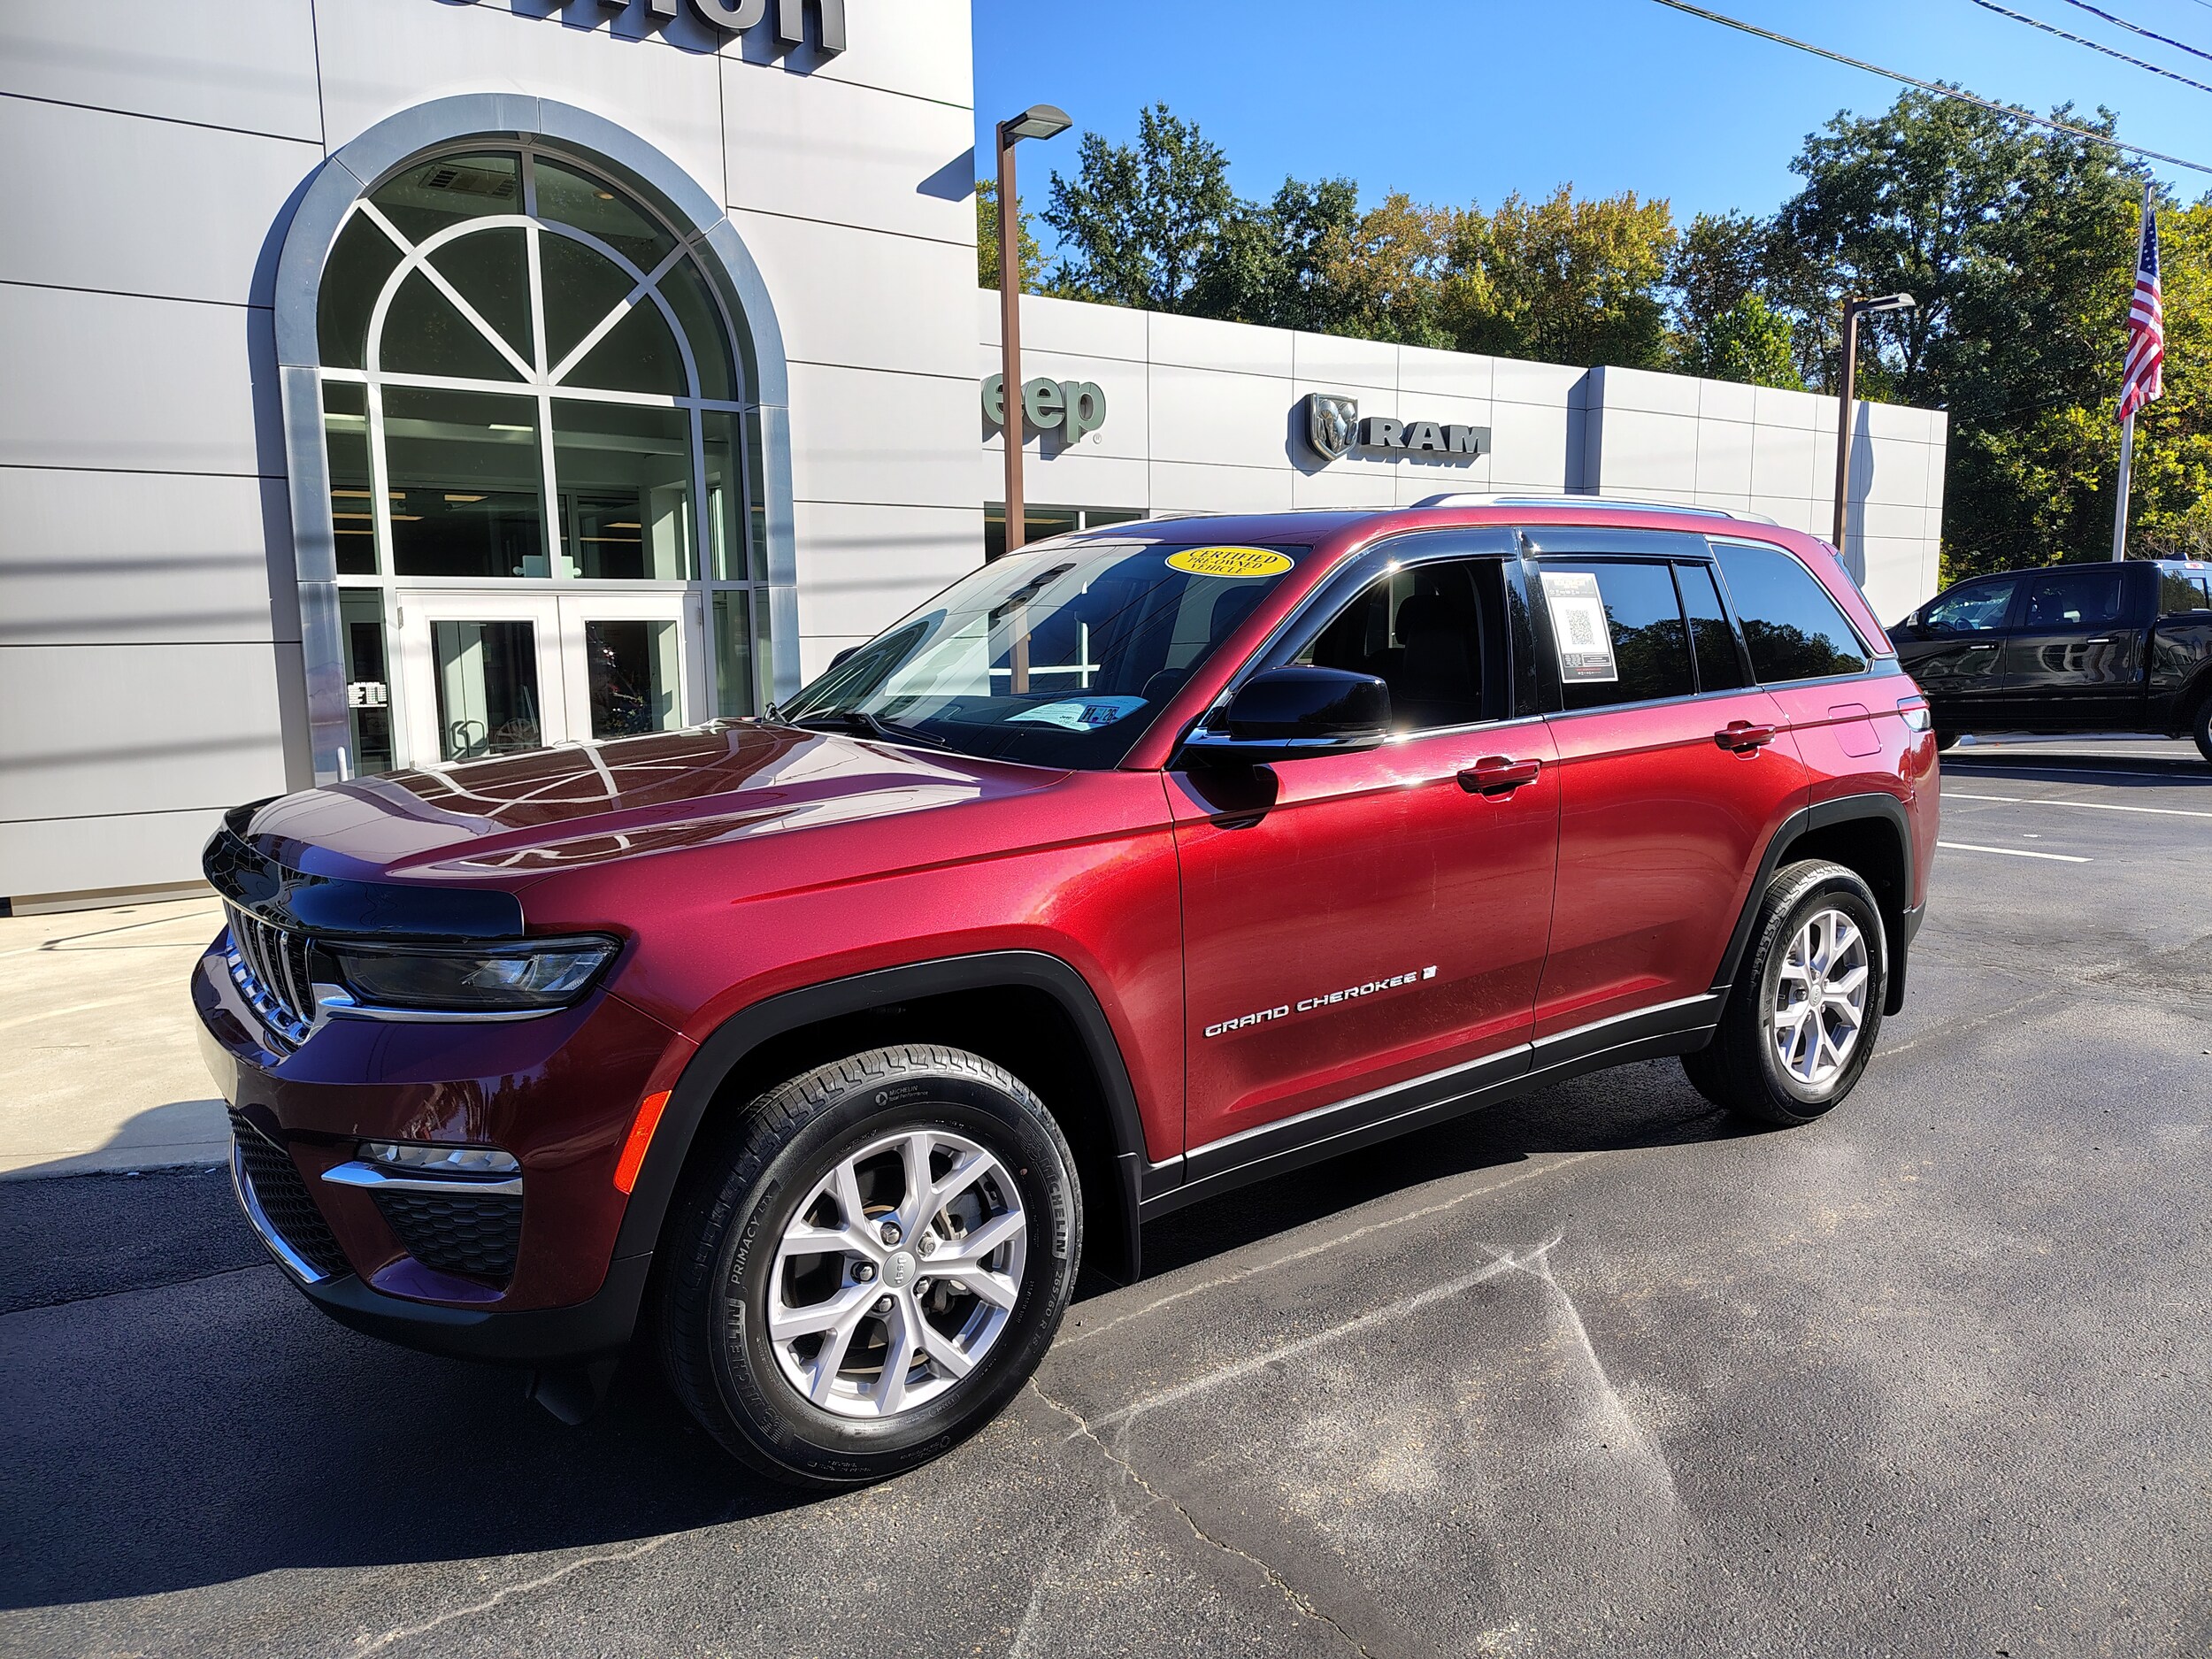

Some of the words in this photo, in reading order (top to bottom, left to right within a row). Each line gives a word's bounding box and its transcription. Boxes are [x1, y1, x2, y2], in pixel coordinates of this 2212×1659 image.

[982, 373, 1106, 443] eep
[1369, 416, 1491, 455] RAM
[1187, 557, 1263, 569] PRE-OWNED
[1189, 549, 1279, 564] CERTIFIED
[1190, 563, 1247, 574] VEHICLE
[1204, 1004, 1289, 1037] GRAND
[1295, 971, 1417, 1013] CHEROKEE
[889, 1085, 919, 1096] MICHELIN
[1038, 1156, 1067, 1254] MICHELIN
[731, 1215, 760, 1285] PRIMACY
[757, 1191, 773, 1214] LTX
[894, 1256, 908, 1285] Jeep
[1045, 1270, 1063, 1317] 265/60
